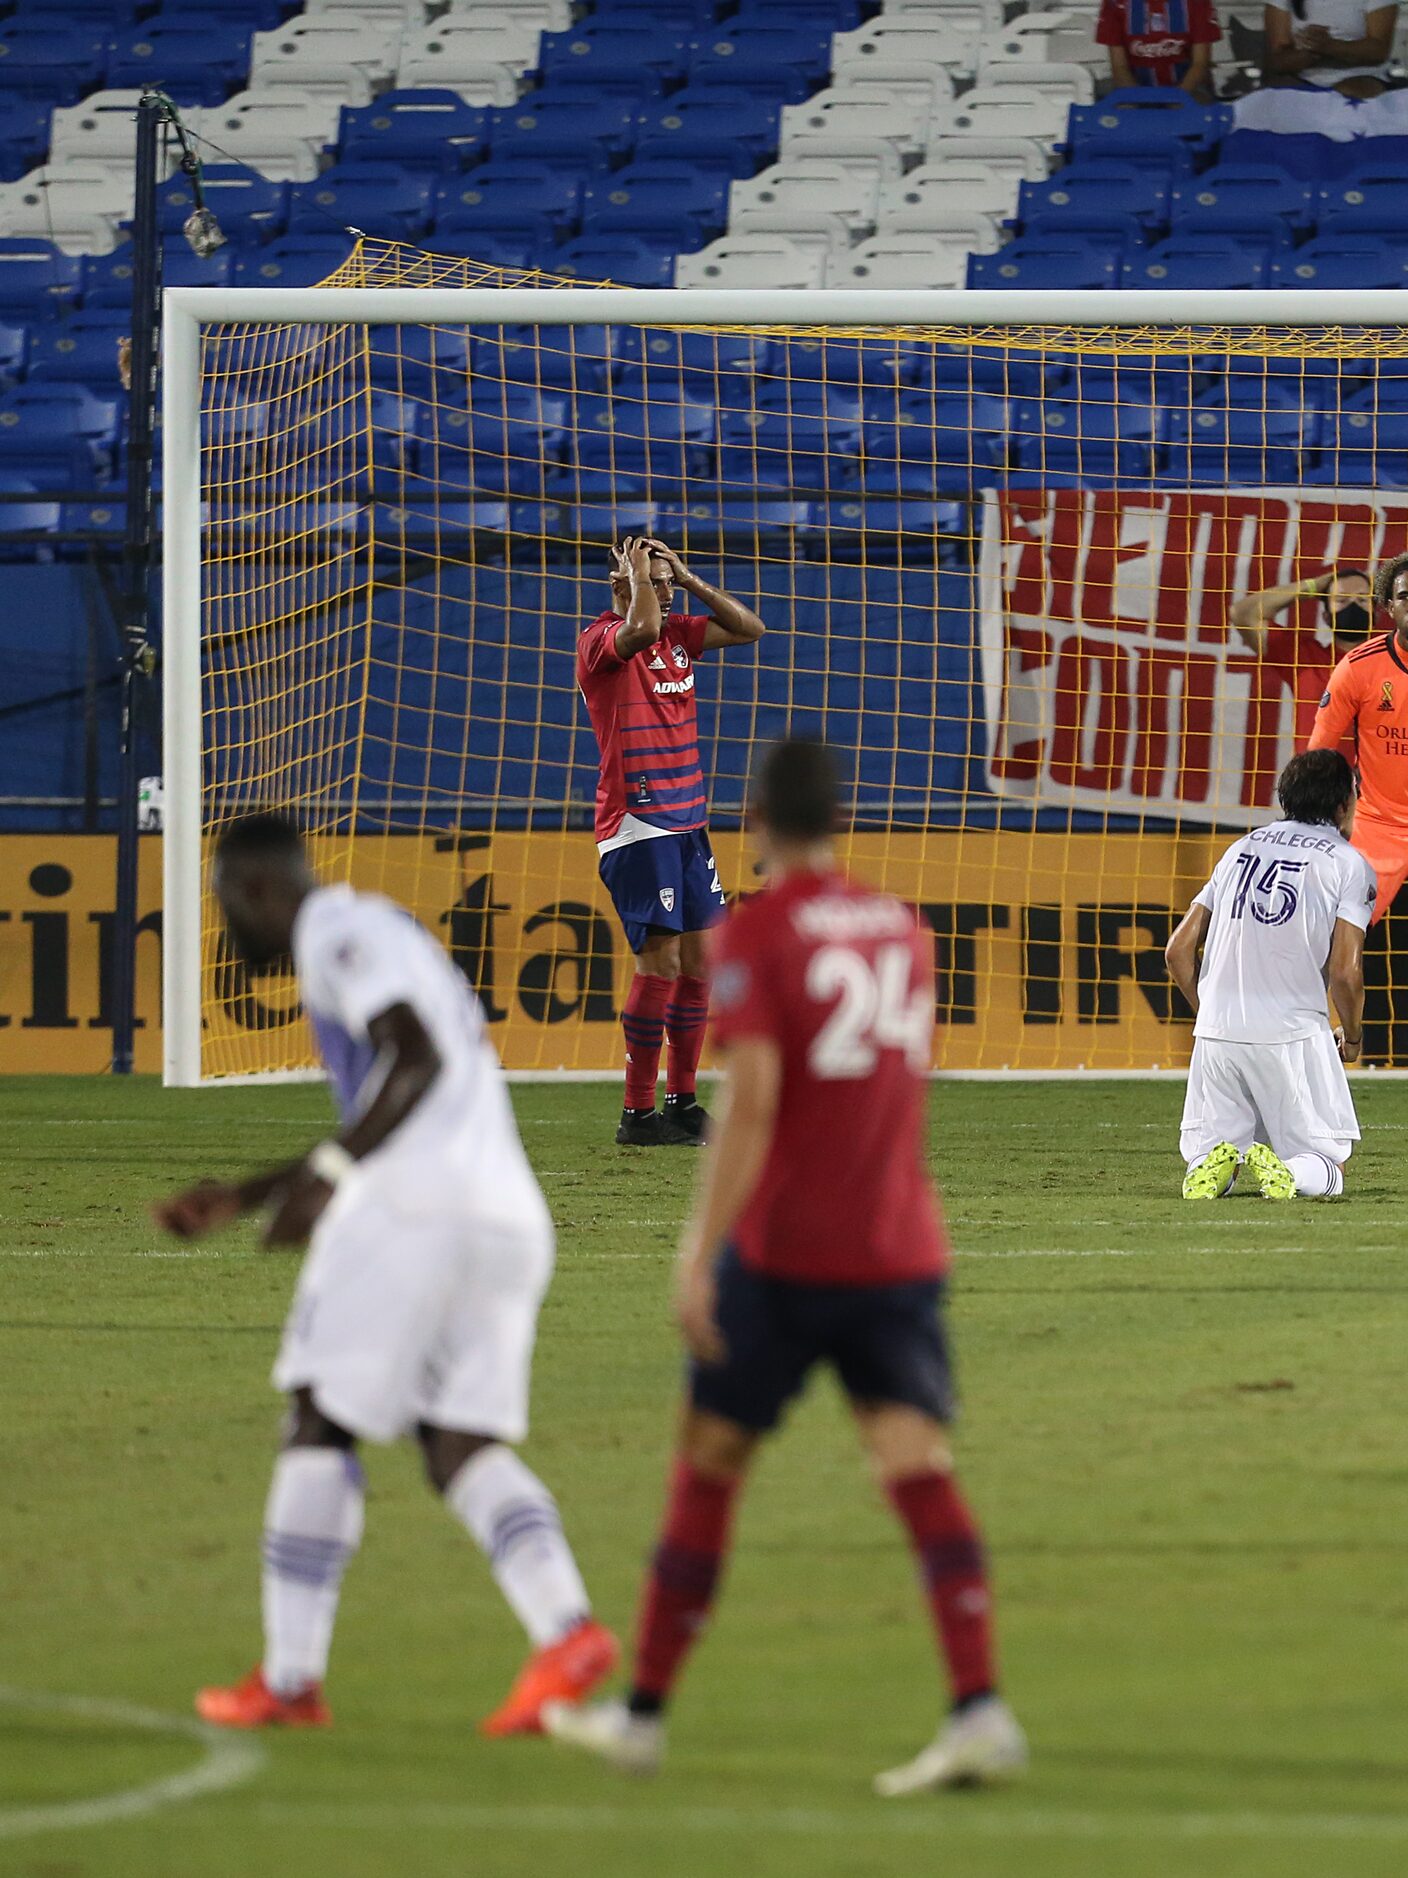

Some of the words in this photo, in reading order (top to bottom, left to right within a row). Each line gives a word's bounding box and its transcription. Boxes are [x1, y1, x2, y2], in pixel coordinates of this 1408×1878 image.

[1231, 852, 1309, 927] 15
[1247, 830, 1336, 859] CHLEGEL
[804, 942, 934, 1080] 24
[921, 903, 1196, 1026] TIR
